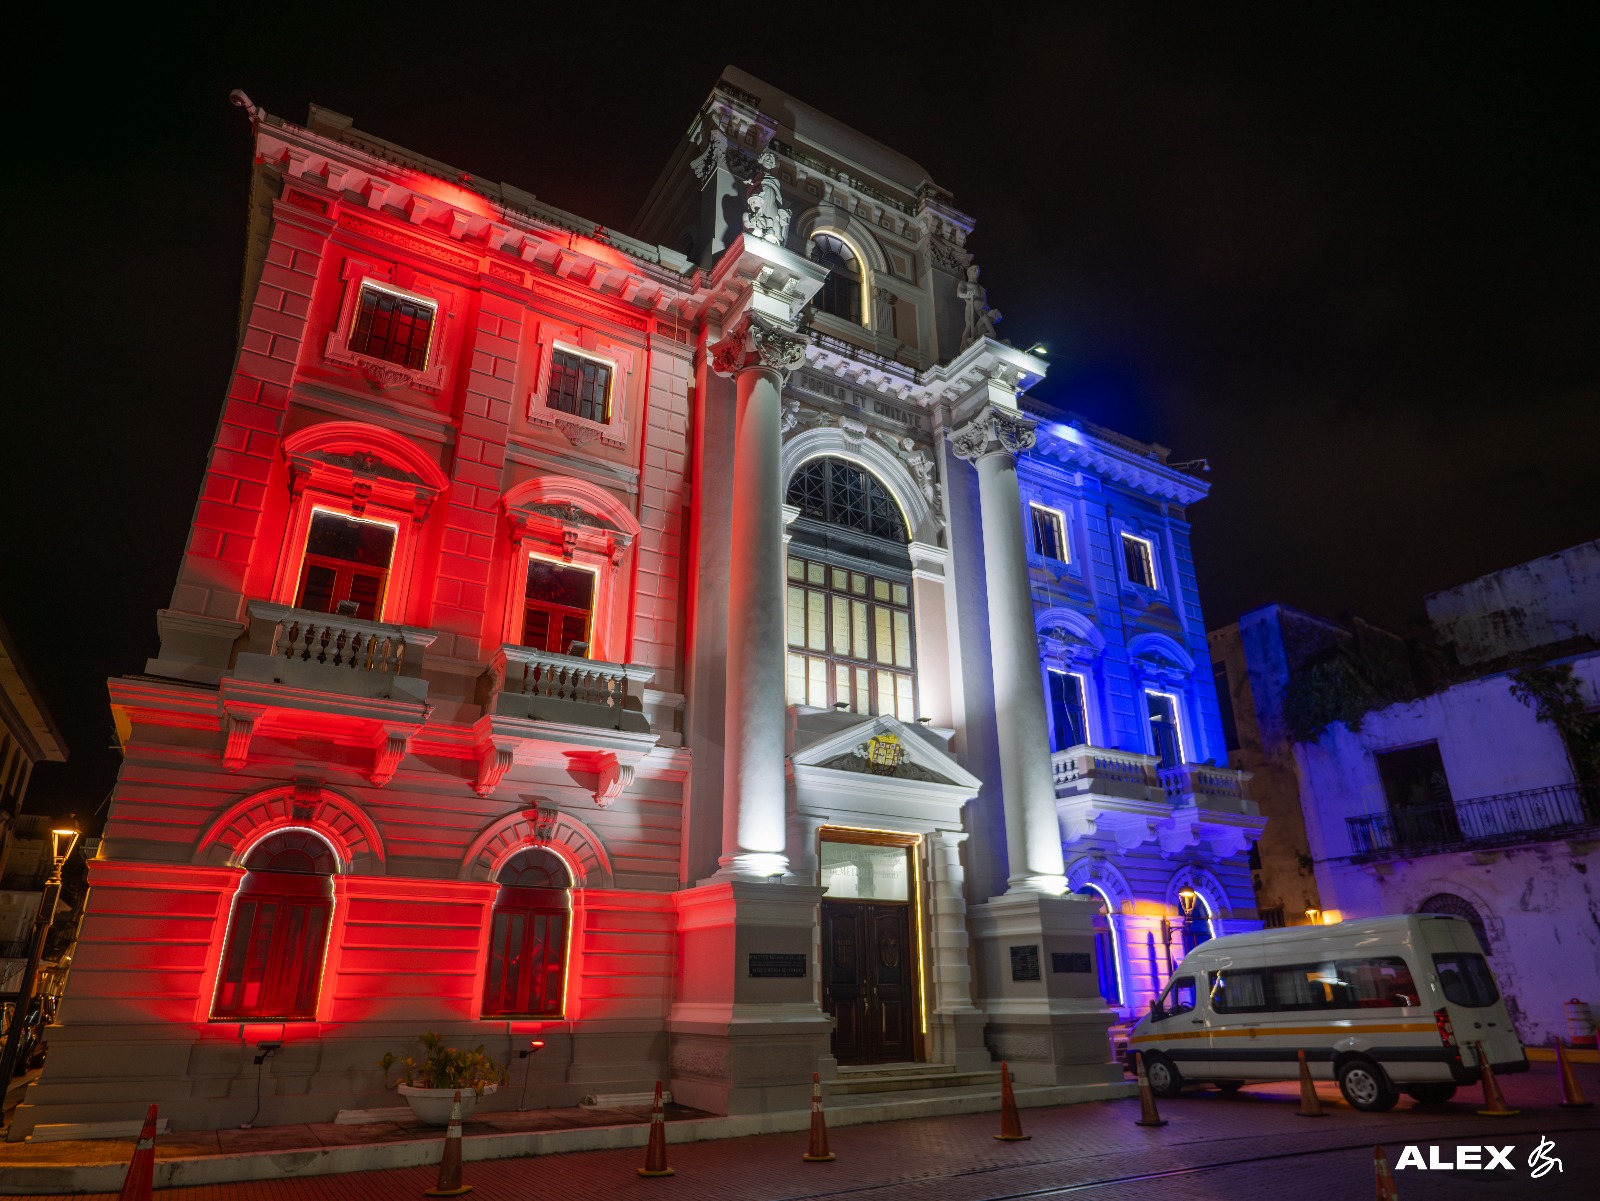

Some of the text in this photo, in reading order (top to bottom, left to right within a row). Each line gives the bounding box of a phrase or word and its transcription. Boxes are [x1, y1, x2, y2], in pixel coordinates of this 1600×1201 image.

[801, 374, 846, 400] POPULO
[852, 391, 867, 408] ET
[873, 400, 922, 429] CIVITATE
